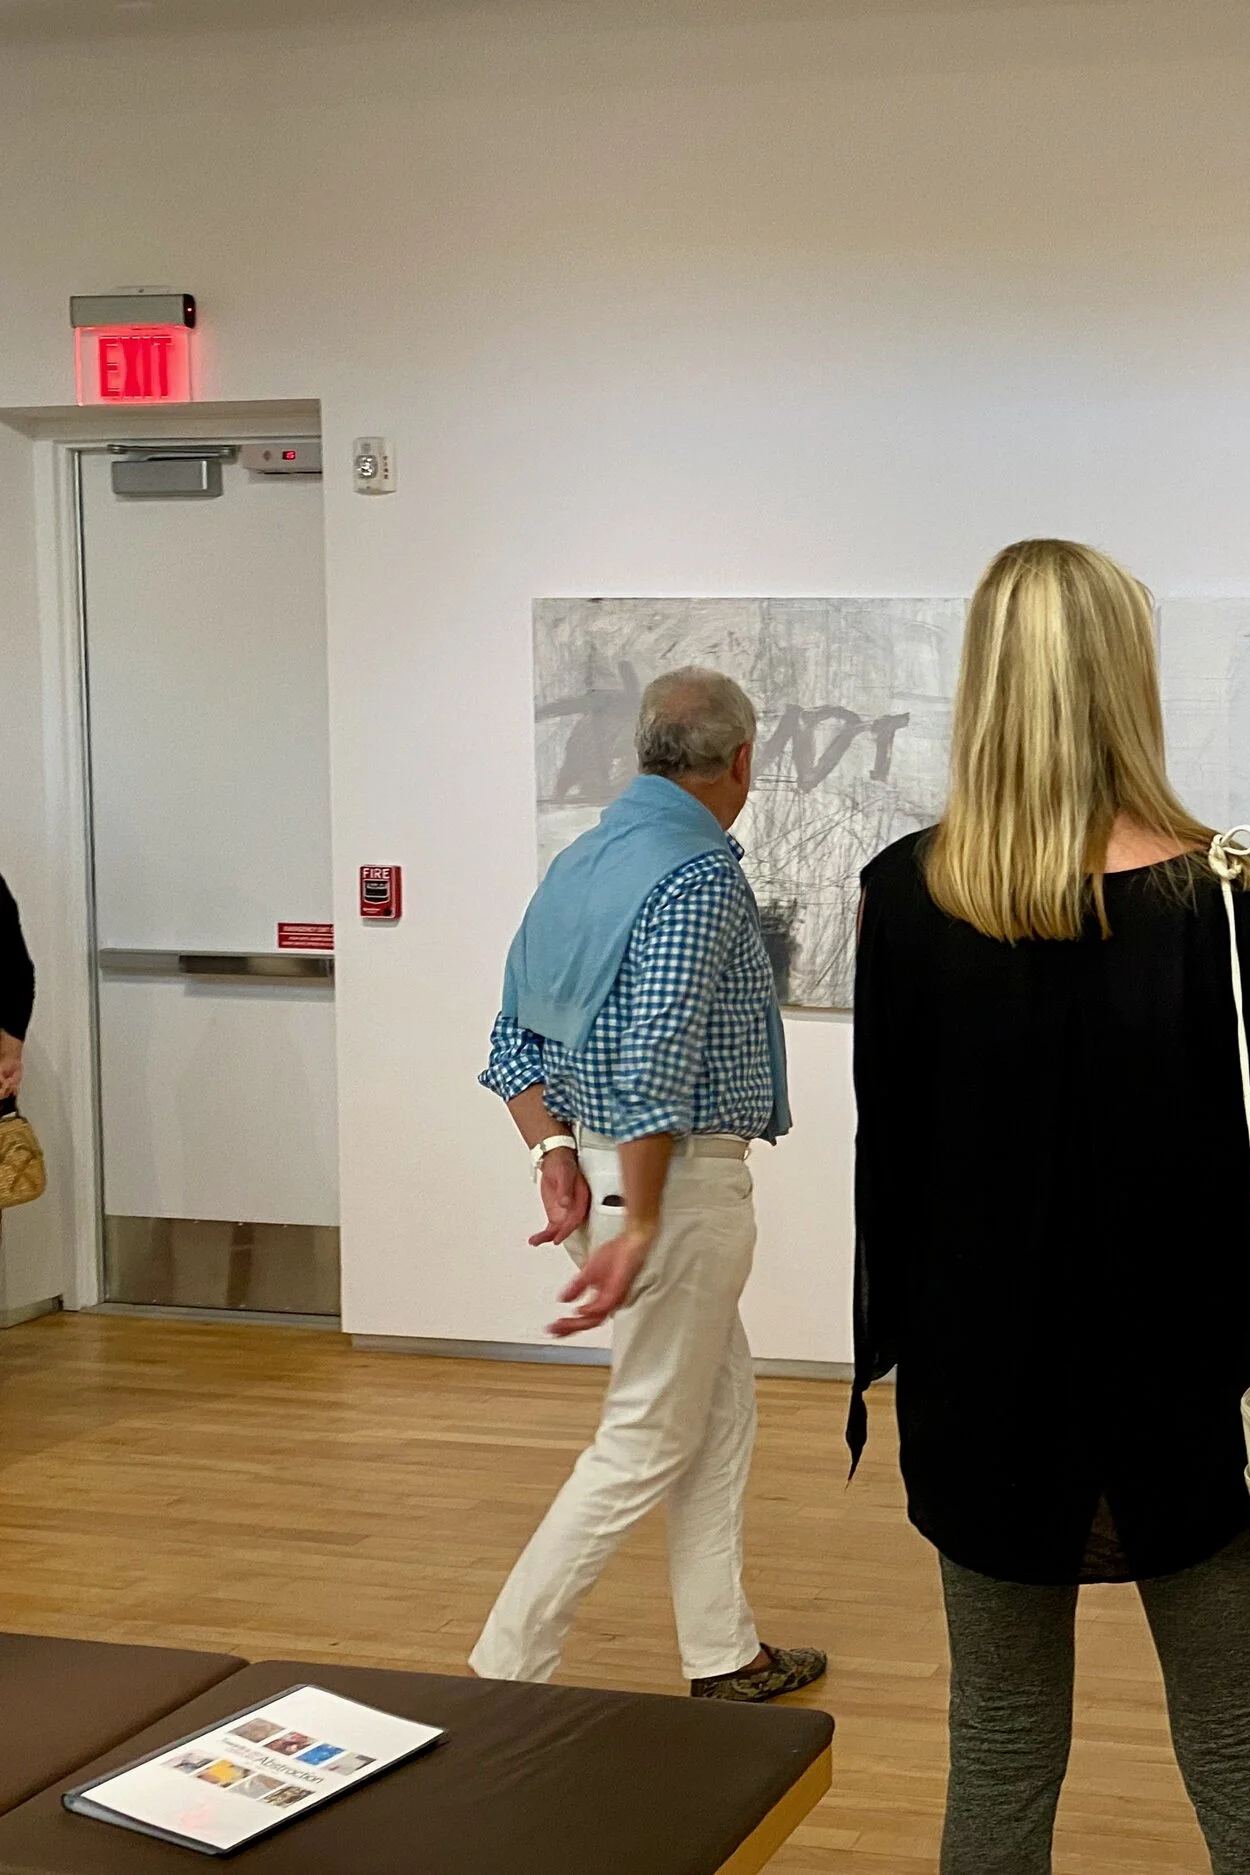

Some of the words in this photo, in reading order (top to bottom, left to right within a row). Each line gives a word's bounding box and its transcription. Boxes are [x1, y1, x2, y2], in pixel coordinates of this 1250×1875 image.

[99, 336, 172, 397] EXIT
[362, 868, 390, 879] FIRE
[254, 1756, 325, 1784] Abstraction
